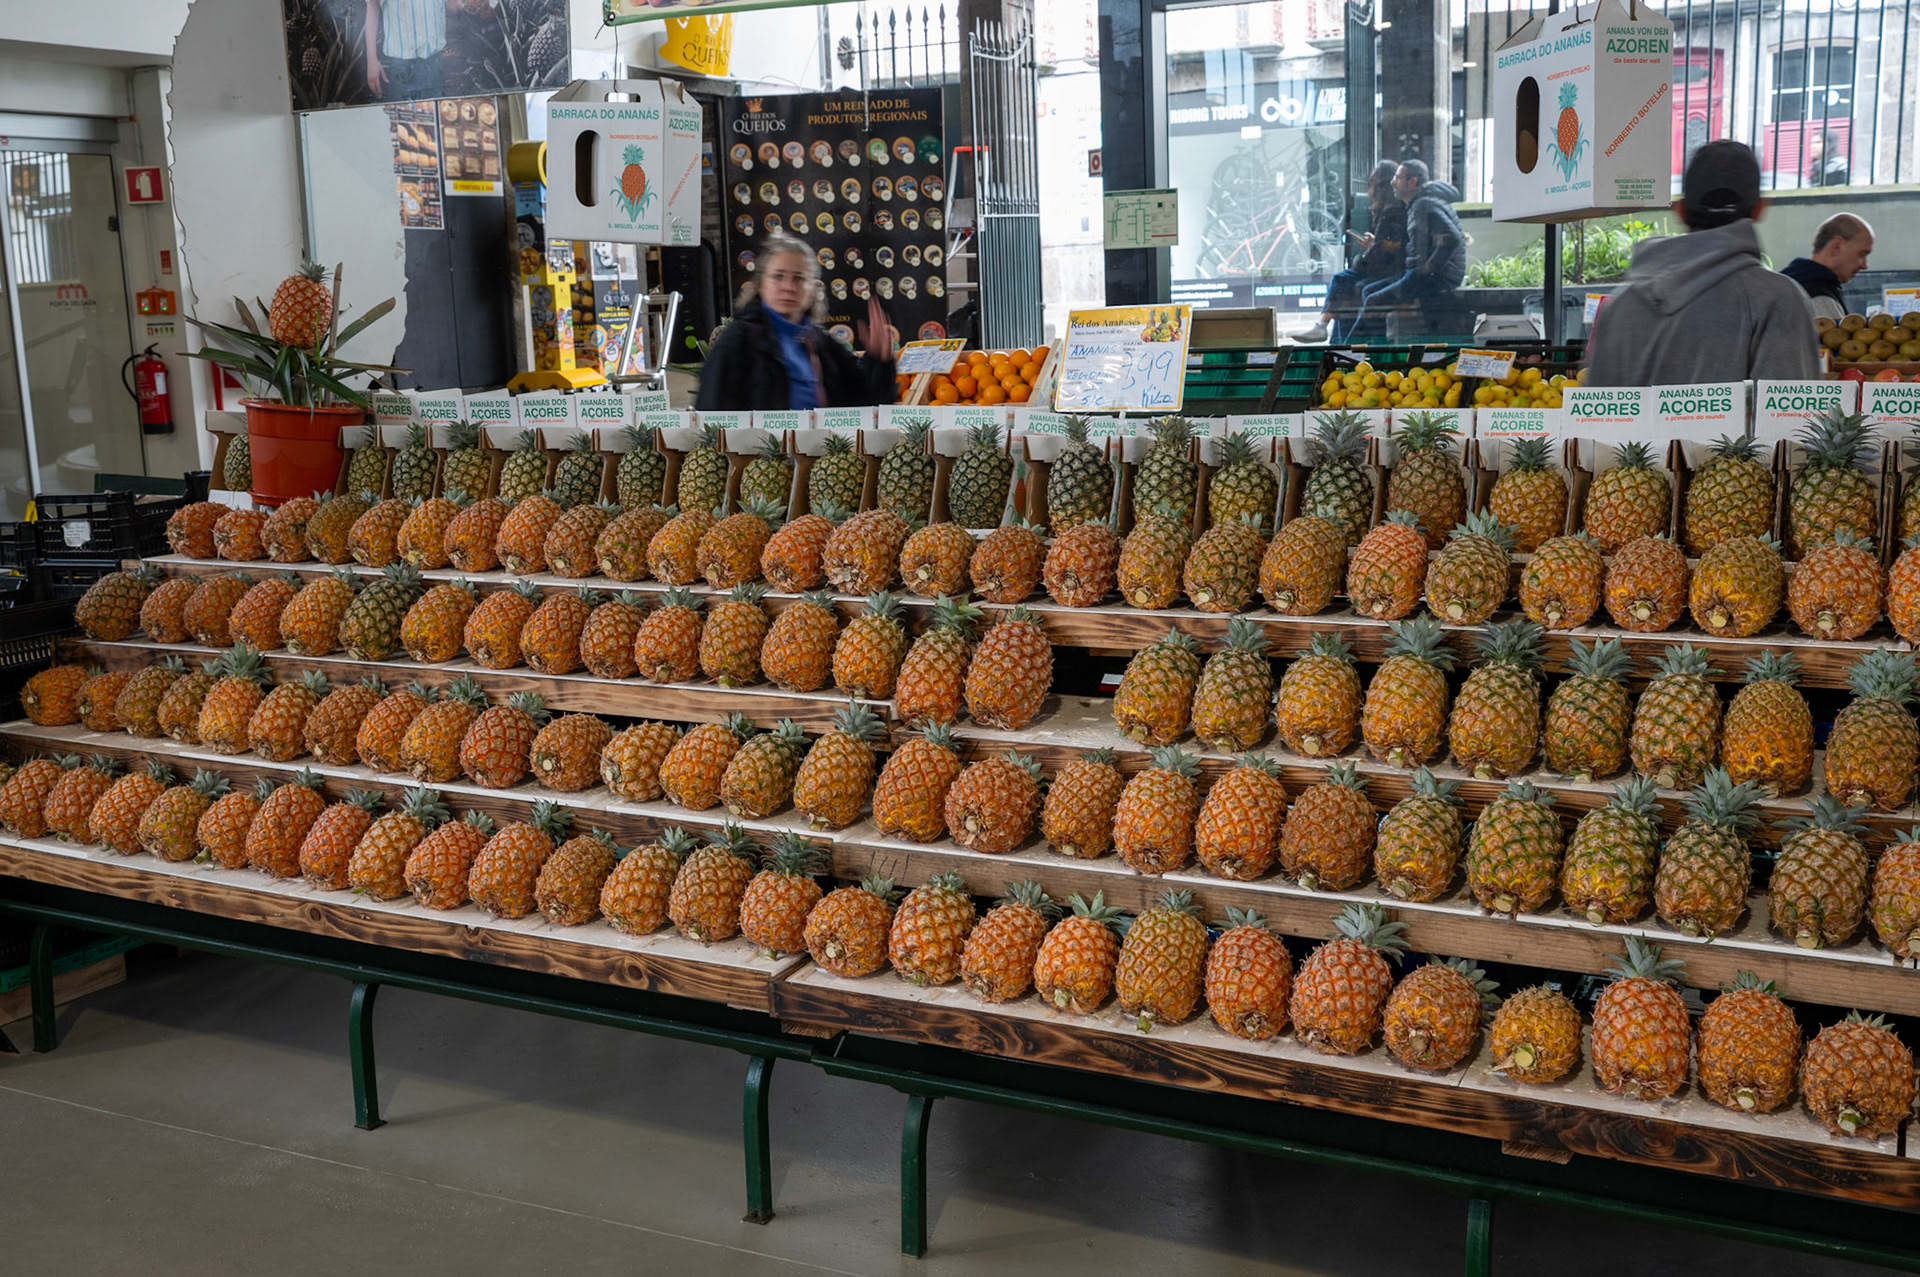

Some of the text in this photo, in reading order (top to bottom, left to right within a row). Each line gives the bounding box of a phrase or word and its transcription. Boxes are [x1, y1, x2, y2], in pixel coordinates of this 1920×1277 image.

[1606, 27, 1668, 36] ANANAS VON DEN
[1498, 30, 1592, 69] BARRACA DO ANANÁS
[1606, 38, 1669, 53] AZOREN
[824, 99, 910, 112] UM REINADO DE
[551, 107, 660, 120] BARRACA DO ANANÁS
[808, 110, 928, 125] PRODUTOS REGIONAIS
[1211, 104, 1248, 120] TOURS
[668, 118, 700, 132] AZOREN
[1604, 116, 1640, 158] NORBERTO
[1638, 82, 1668, 118] BOTELHO
[732, 119, 786, 135] QUEIJOS
[1071, 320, 1084, 329] Rei
[1086, 320, 1100, 328] dos
[1707, 387, 1732, 396] DOS
[1816, 385, 1842, 394] DOS
[608, 398, 623, 406] DOS
[643, 394, 666, 404] MICHAEL
[1617, 392, 1641, 400] DOS
[377, 405, 412, 415] AÇORES
[1659, 398, 1732, 415] AÇORES
[1765, 396, 1841, 412] AÇORES
[421, 409, 458, 420] AÇORES
[471, 408, 511, 420] AÇORES
[524, 407, 568, 419] AÇORES
[581, 407, 624, 419] AÇORES
[1570, 403, 1640, 418] AÇORES
[824, 418, 861, 428] AÇORES
[955, 417, 994, 426] AÇORES
[1028, 414, 1056, 423] ANANAS
[1491, 421, 1544, 432] AÇORES
